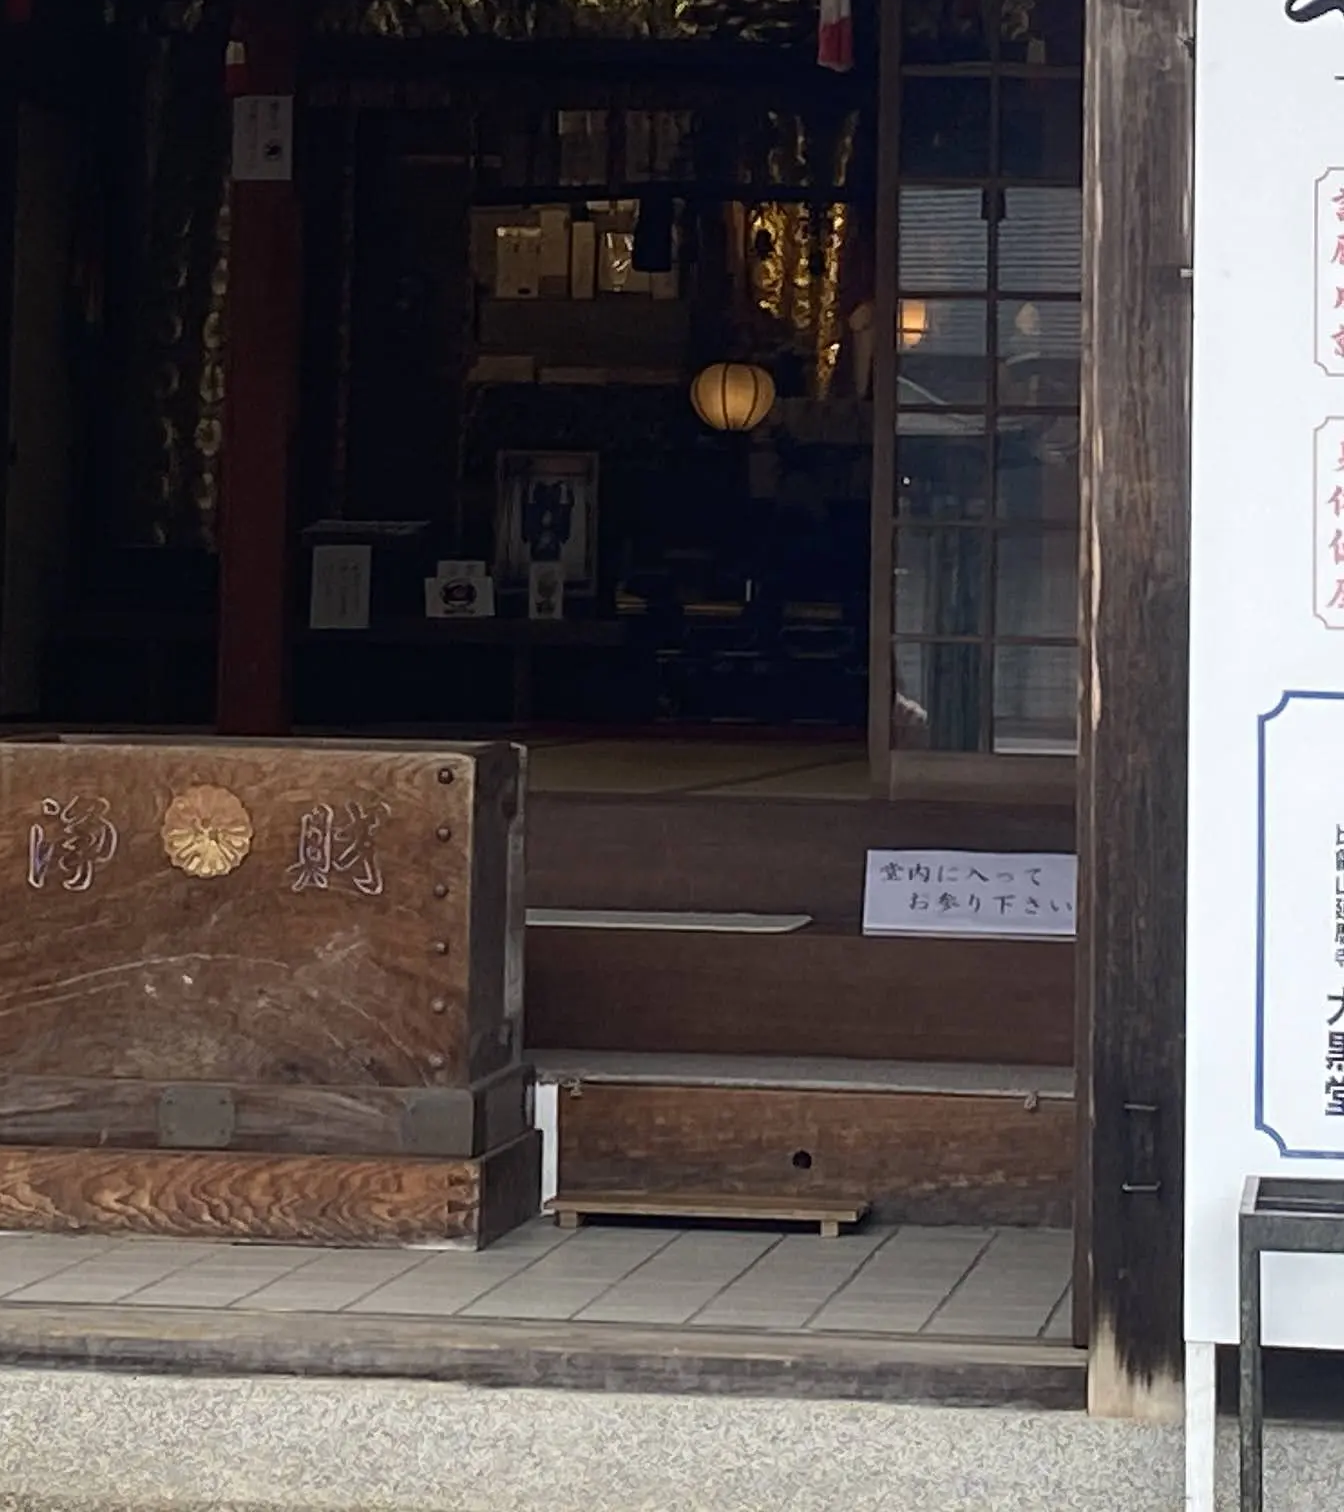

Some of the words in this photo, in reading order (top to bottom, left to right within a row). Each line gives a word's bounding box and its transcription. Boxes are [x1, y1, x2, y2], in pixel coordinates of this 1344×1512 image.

[909, 891, 1073, 916] お参り下さい
